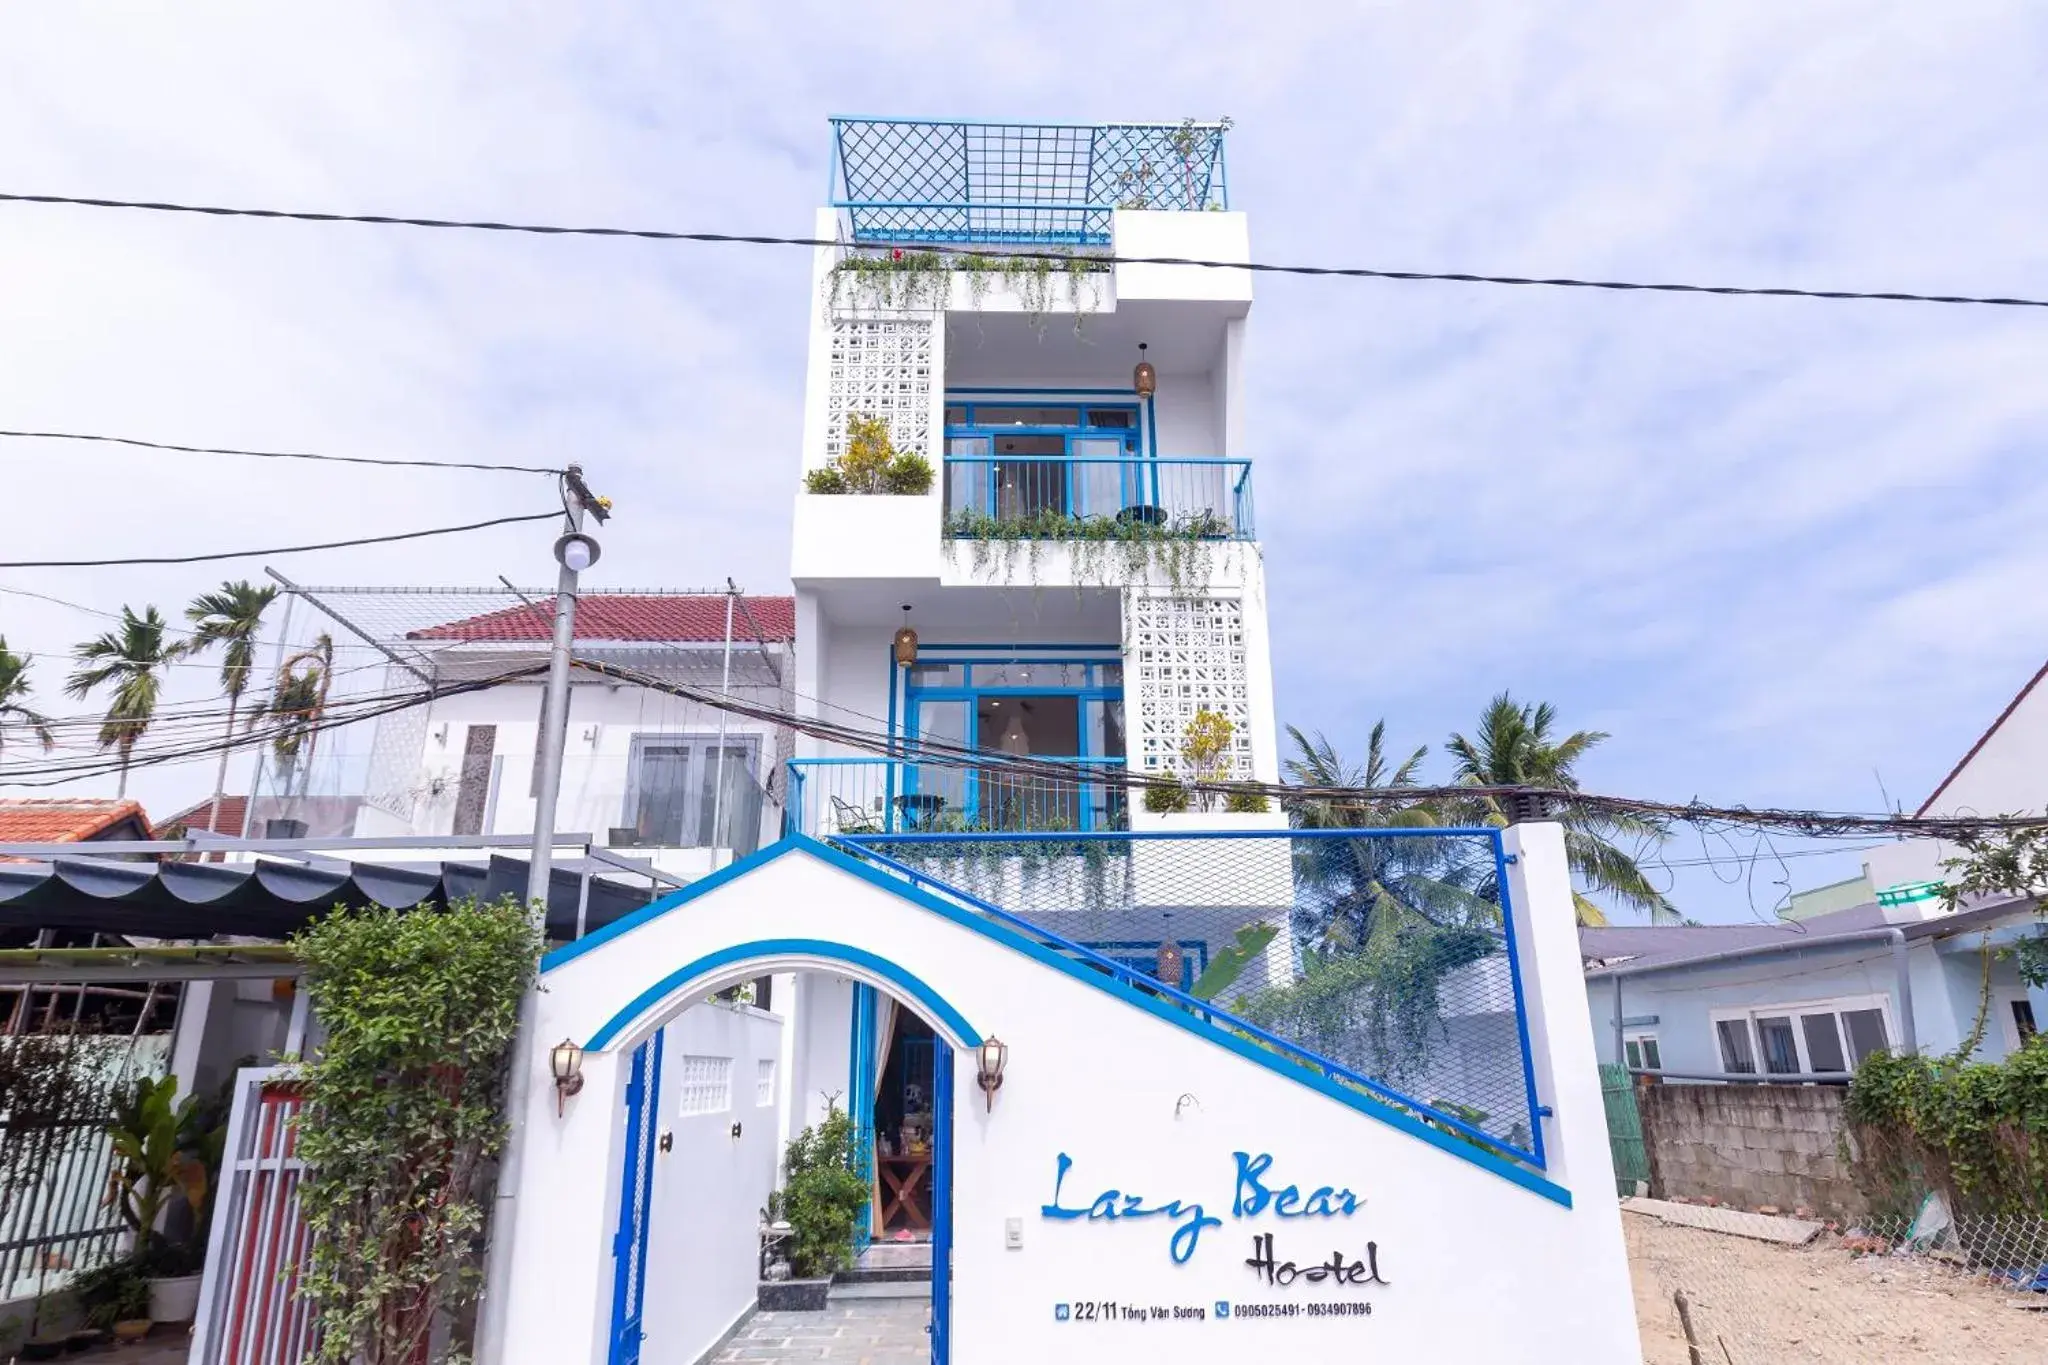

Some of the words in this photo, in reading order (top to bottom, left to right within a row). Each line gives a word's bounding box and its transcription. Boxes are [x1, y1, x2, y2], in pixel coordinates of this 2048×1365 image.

[1041, 1151, 1222, 1265] Lazy
[1233, 1151, 1365, 1219] Bear
[1245, 1232, 1390, 1287] Hostel
[1074, 1301, 1117, 1322] 22/11
